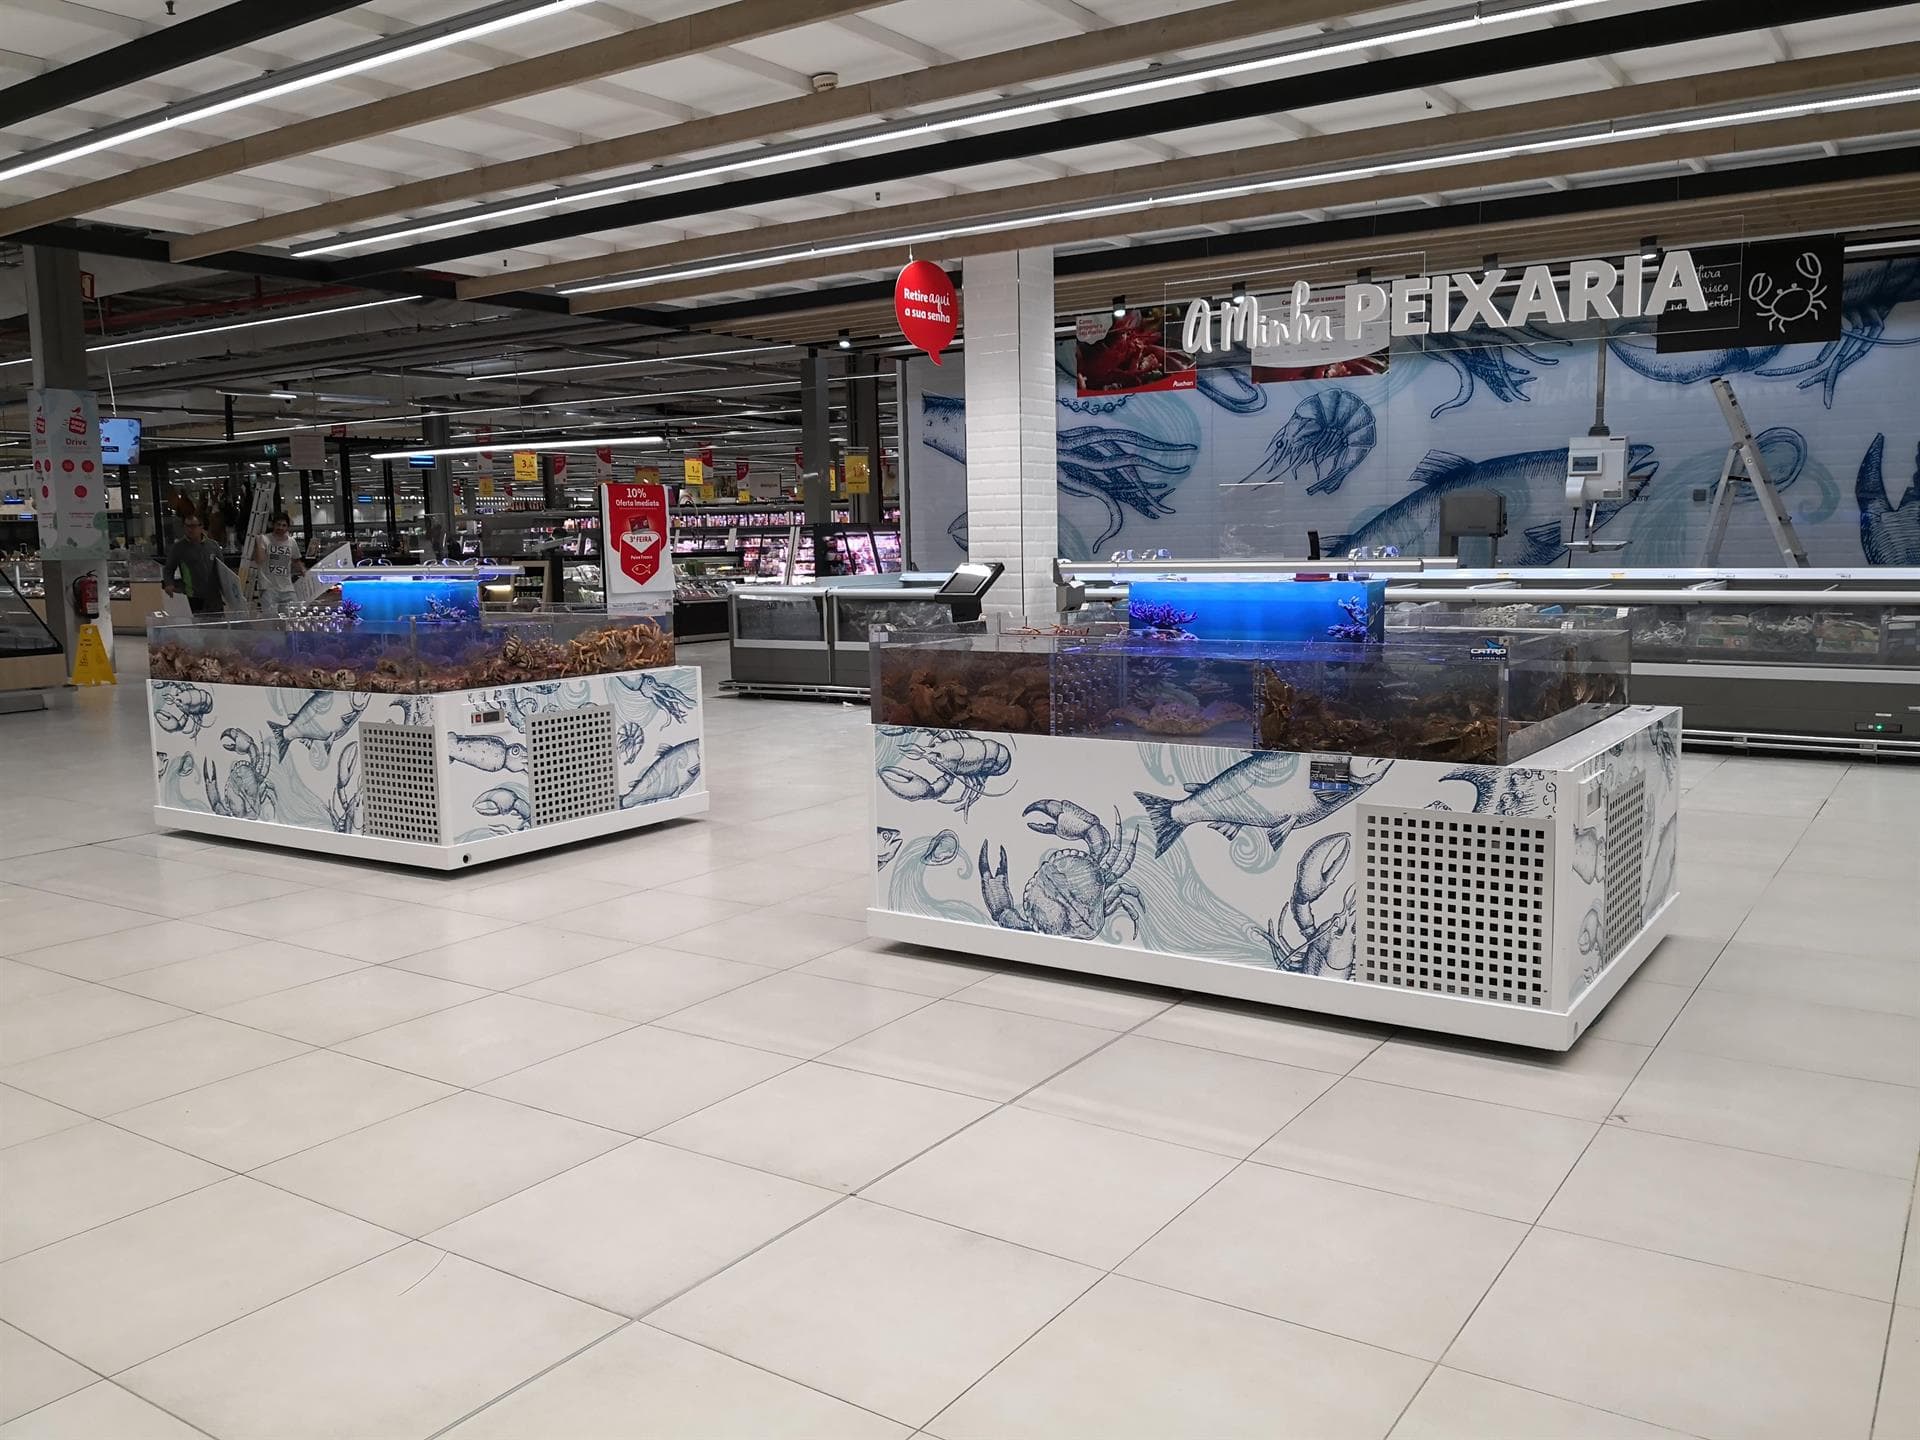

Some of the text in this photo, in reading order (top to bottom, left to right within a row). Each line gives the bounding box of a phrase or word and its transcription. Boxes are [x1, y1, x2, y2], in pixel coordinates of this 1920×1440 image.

[903, 287, 951, 313] Retire aqui
[1220, 281, 1333, 351] Minha
[1344, 249, 1709, 341] PEIXARIA
[904, 308, 951, 324] a sua senha
[65, 438, 88, 446] Drive
[626, 487, 647, 499] 10%
[615, 498, 660, 507] Oferta Imediata
[636, 535, 652, 543] FEIRA
[270, 545, 291, 555] USA
